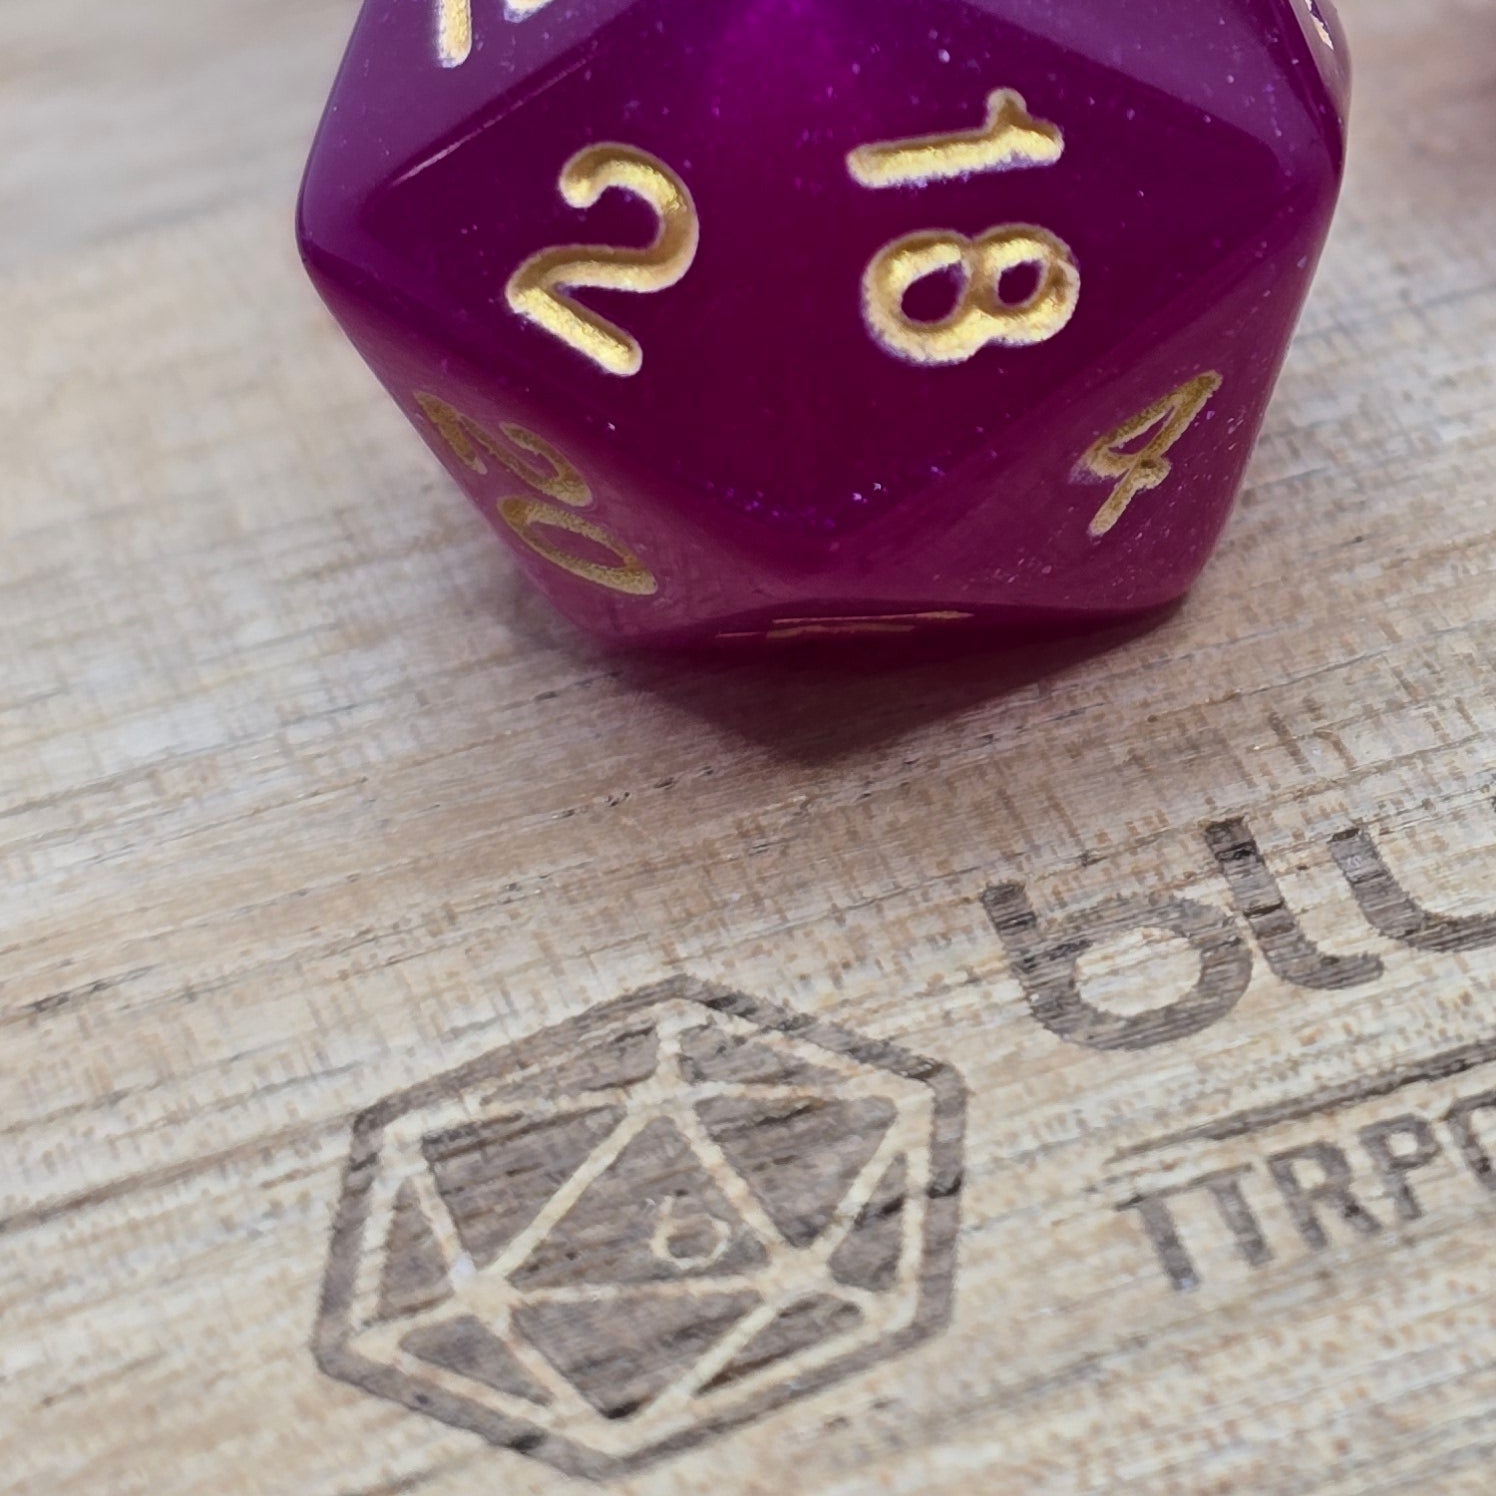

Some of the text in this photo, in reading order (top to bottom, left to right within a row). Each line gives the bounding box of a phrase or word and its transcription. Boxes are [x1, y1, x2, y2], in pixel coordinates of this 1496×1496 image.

[506, 142, 700, 377] 2
[846, 87, 1081, 366] 18
[412, 389, 659, 596] 20
[1076, 369, 1224, 539] 4
